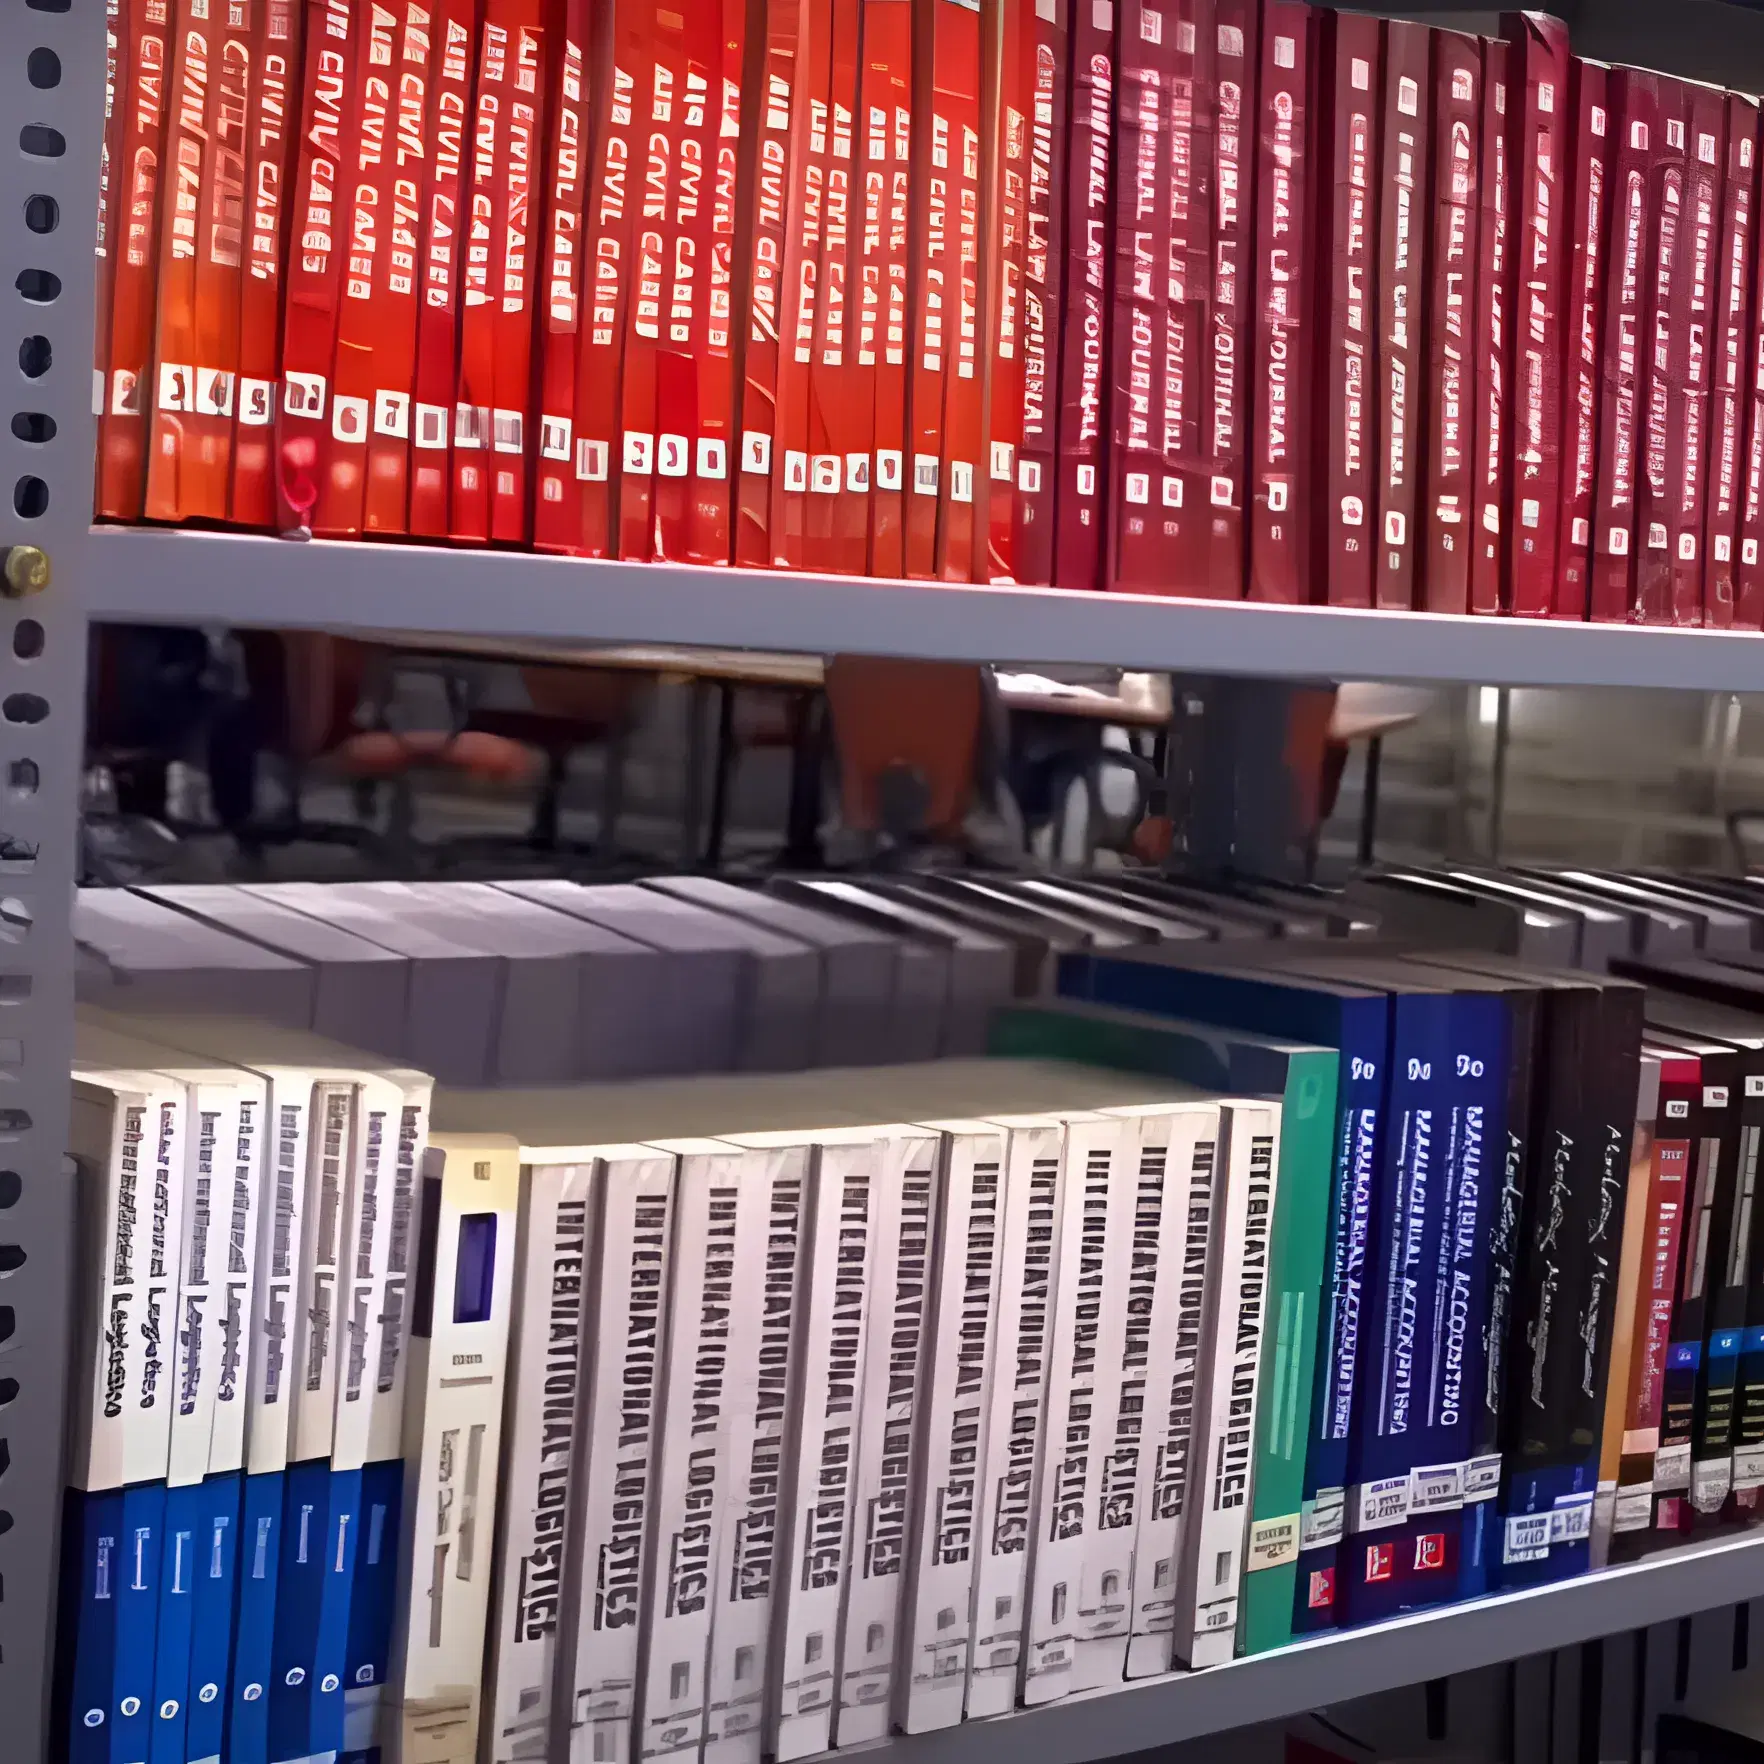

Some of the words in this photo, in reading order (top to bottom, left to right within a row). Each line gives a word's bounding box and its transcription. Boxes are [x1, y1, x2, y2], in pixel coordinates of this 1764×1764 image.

[260, 55, 286, 146] CIVIL
[359, 77, 389, 170] CIVIL
[436, 92, 464, 181] CIVIL
[475, 94, 498, 184] CIVIL
[556, 107, 578, 199] CIVIL
[600, 137, 628, 225] CIVIL
[678, 139, 701, 224] CIVIL
[759, 141, 784, 227] CIVIL
[803, 165, 822, 247] CIVIL
[827, 170, 847, 251] CIVIL
[928, 178, 946, 258] CIVIL
[618, 1195, 667, 1449] INTERNATIONAL
[691, 1188, 738, 1438] INTERNATIONAL
